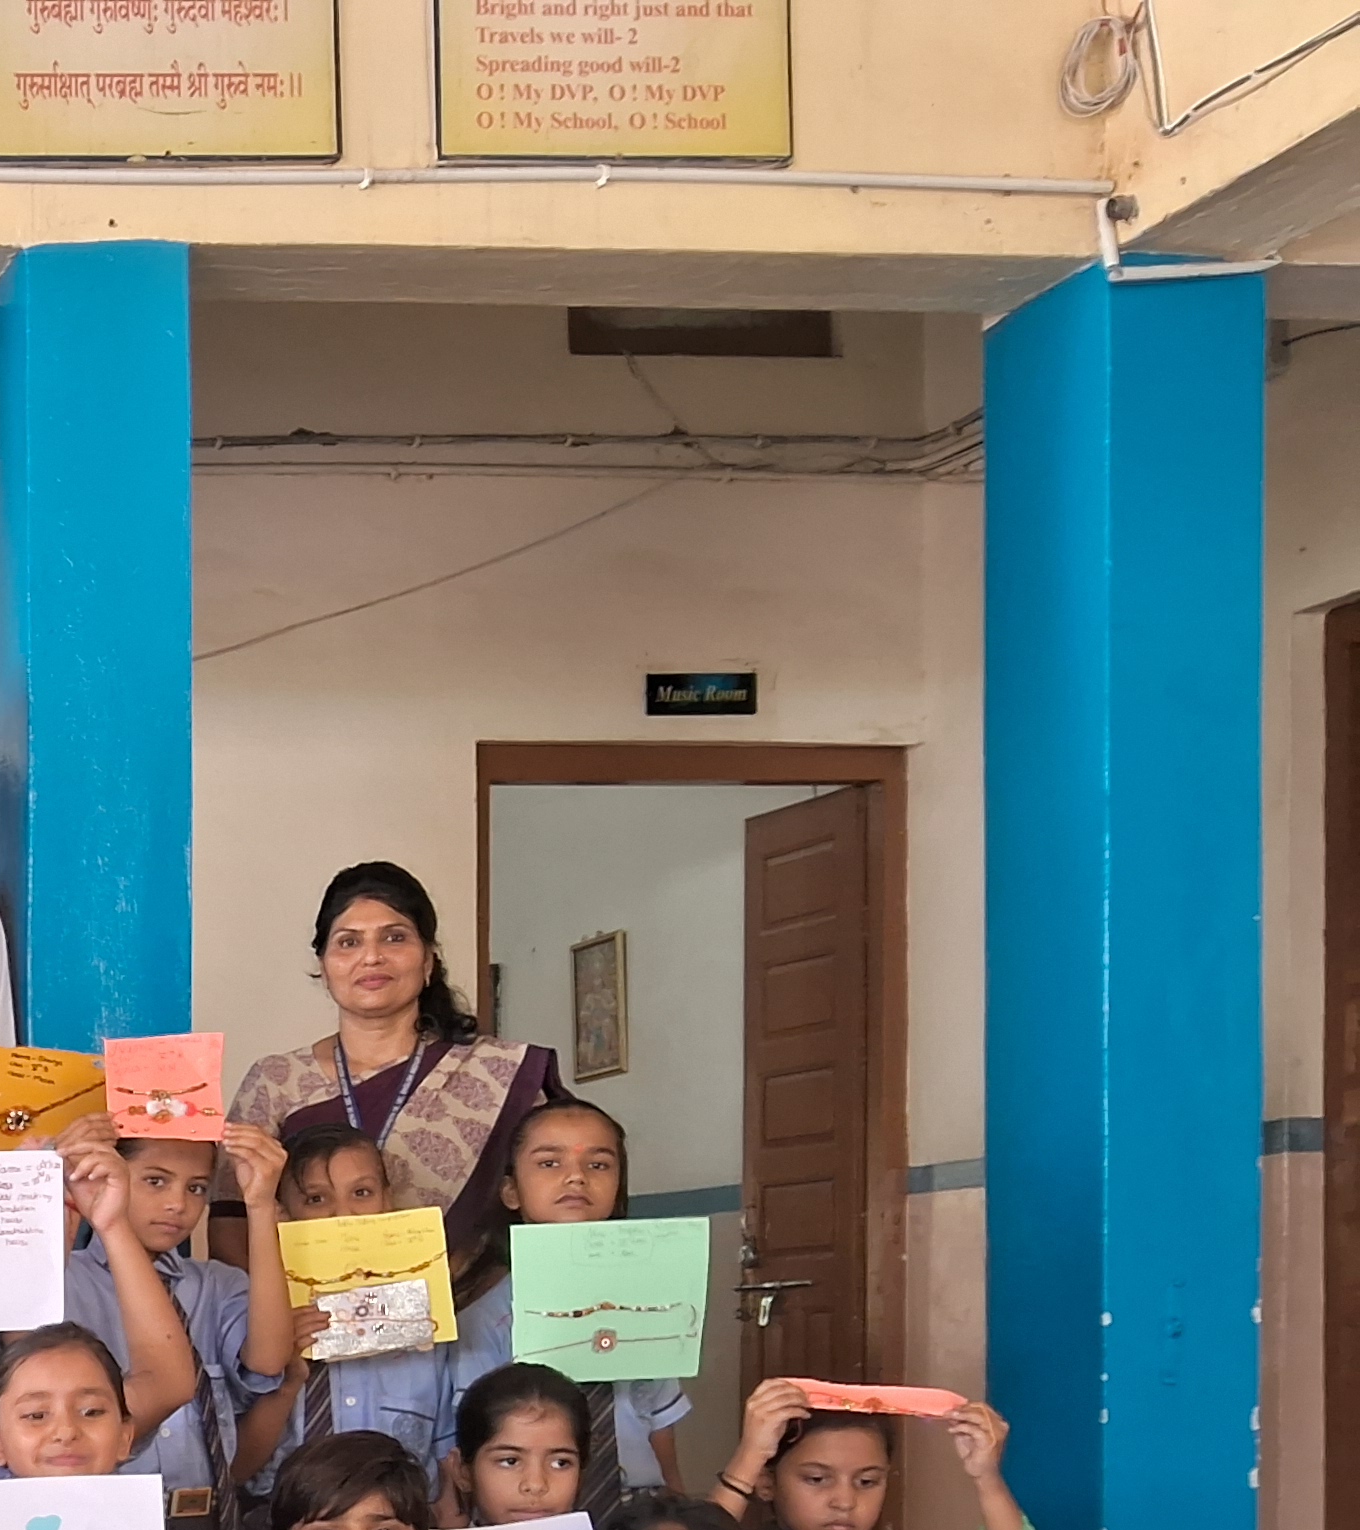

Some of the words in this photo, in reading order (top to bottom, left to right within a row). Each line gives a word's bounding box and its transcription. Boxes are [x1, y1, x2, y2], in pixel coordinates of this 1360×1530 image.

[541, 1, 576, 17] and
[584, 0, 628, 21] right
[634, 0, 668, 20] just
[676, 0, 710, 17] and
[717, 0, 753, 17] that
[476, 26, 544, 45] Travels
[550, 31, 575, 45] we
[476, 55, 572, 77] Spreading
[579, 55, 622, 77] good
[149, 60, 182, 98] तस्मै
[187, 62, 209, 98] श्री
[512, 84, 542, 105] My
[645, 84, 676, 106] My
[682, 84, 726, 102] DVP
[512, 112, 543, 133] My
[664, 112, 727, 130] School
[655, 685, 700, 703] Music
[702, 684, 748, 702] Room
